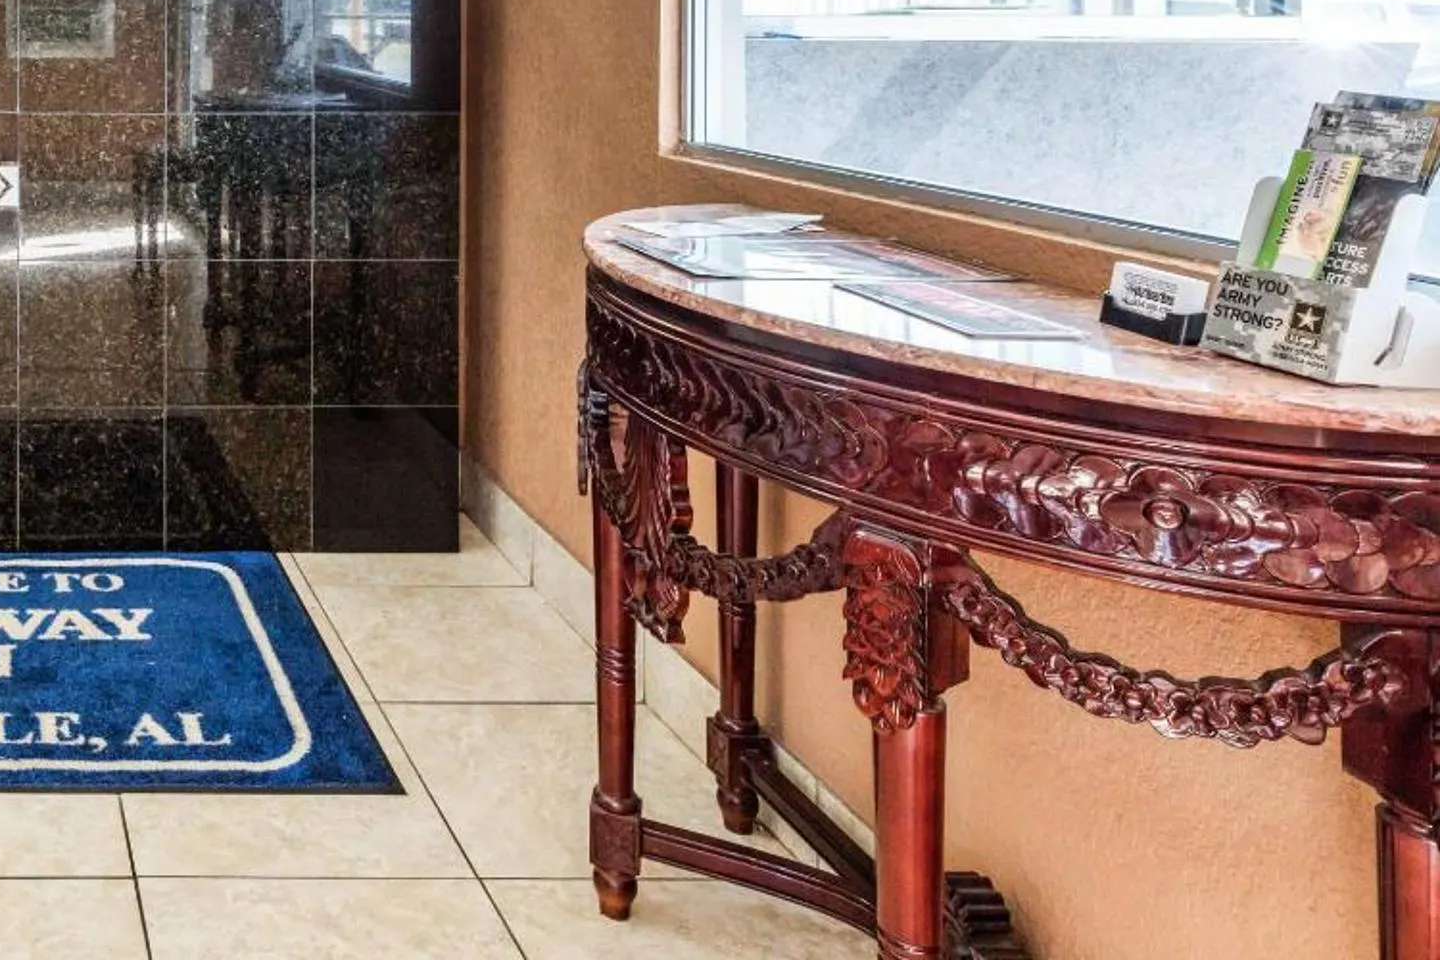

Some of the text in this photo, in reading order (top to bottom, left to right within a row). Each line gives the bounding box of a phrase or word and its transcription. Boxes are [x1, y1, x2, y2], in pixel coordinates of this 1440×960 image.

[1331, 242, 1368, 259] TURE
[1325, 258, 1369, 275] CCESS
[1221, 271, 1289, 296] ARE YOU
[1217, 288, 1262, 308] ARMY
[1213, 304, 1284, 331] STRONG?
[43, 572, 124, 593] TO
[126, 711, 233, 746] AL
